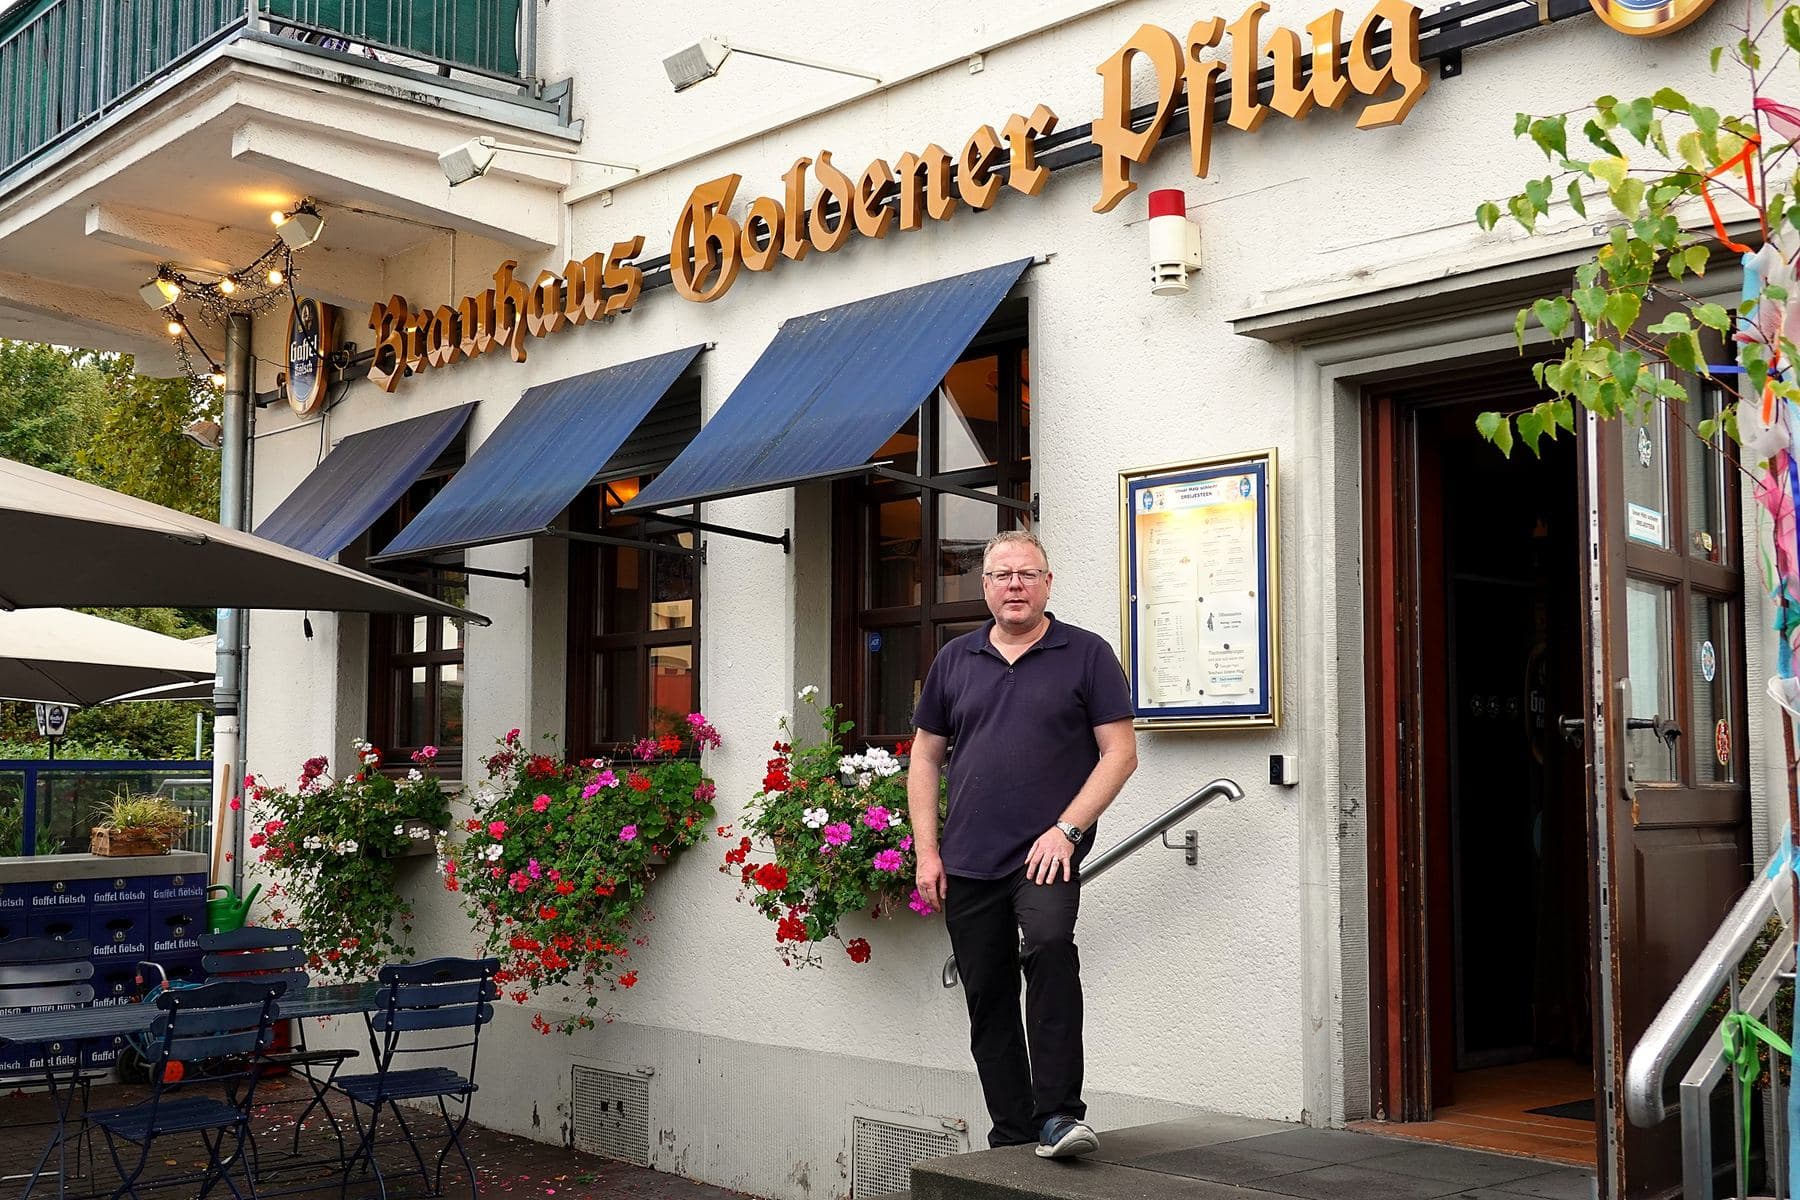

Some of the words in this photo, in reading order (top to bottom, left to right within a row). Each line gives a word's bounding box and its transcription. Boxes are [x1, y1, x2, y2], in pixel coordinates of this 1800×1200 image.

[367, 235, 645, 393] Brauhaus
[670, 103, 1059, 303] Goldener
[1092, 0, 1430, 214] Pflug
[94, 891, 117, 902] Gaffel
[153, 888, 176, 899] Gaffel
[32, 895, 57, 906] Gaffel
[93, 944, 117, 955] Gaffel
[118, 943, 145, 954] Kölsch
[154, 940, 177, 951] Gaffel
[92, 1050, 115, 1062] Gaffel
